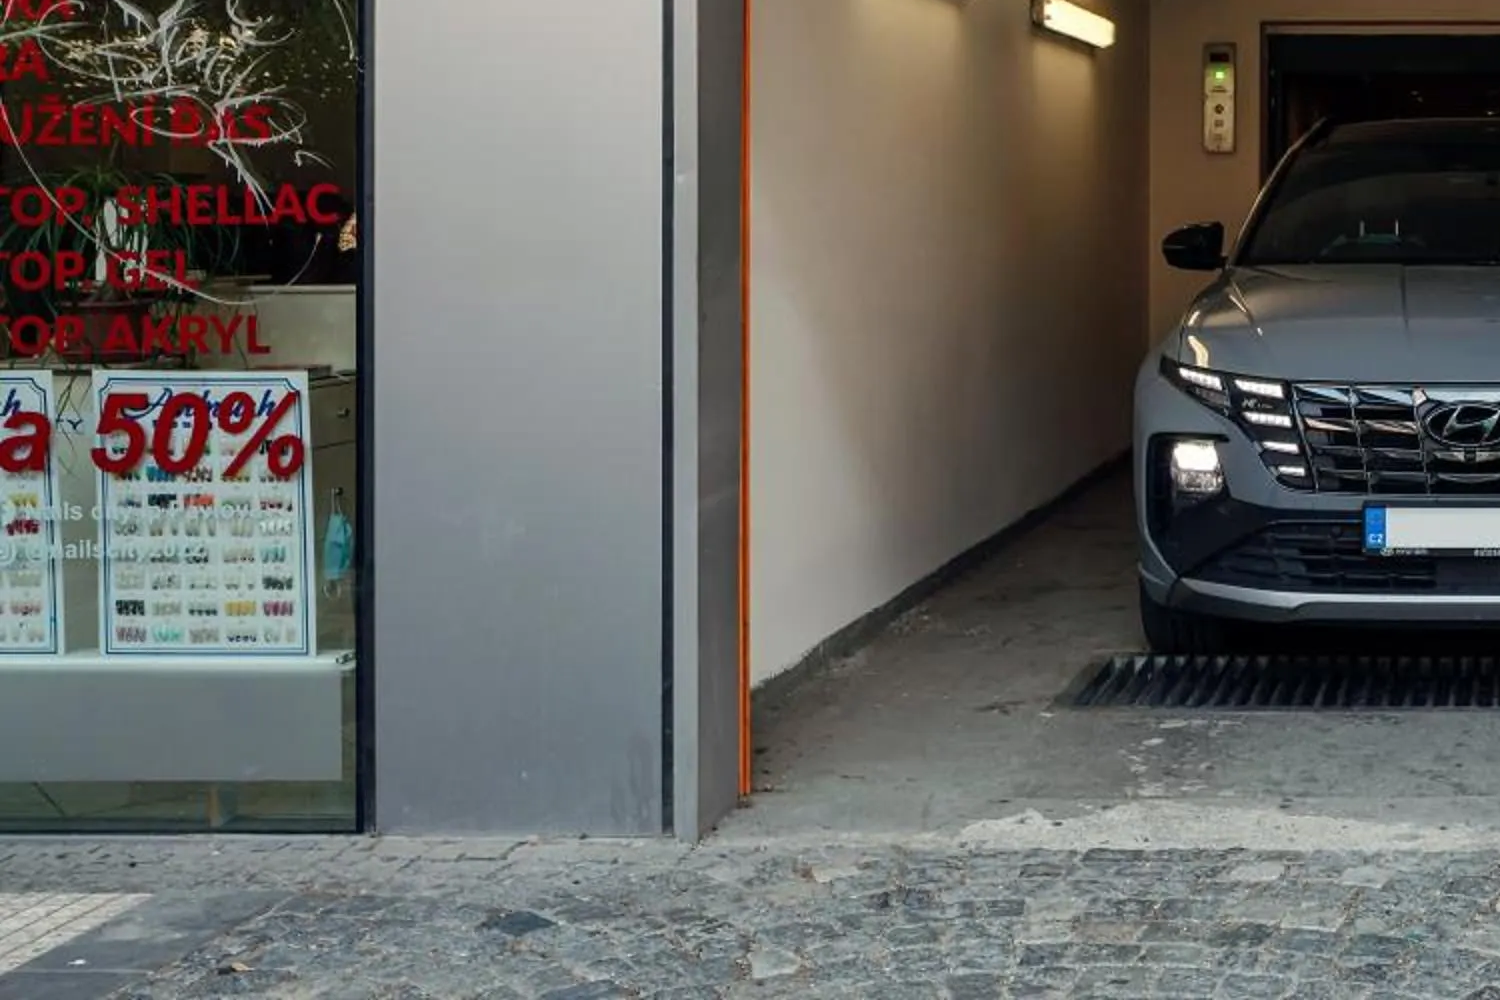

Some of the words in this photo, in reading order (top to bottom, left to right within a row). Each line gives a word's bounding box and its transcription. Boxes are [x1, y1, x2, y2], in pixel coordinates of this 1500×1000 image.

[116, 183, 341, 227] SHELLAC
[106, 248, 200, 292] GEL
[102, 313, 272, 356] AKRYL
[91, 390, 305, 478] 50%
[1368, 533, 1384, 544] CZ
